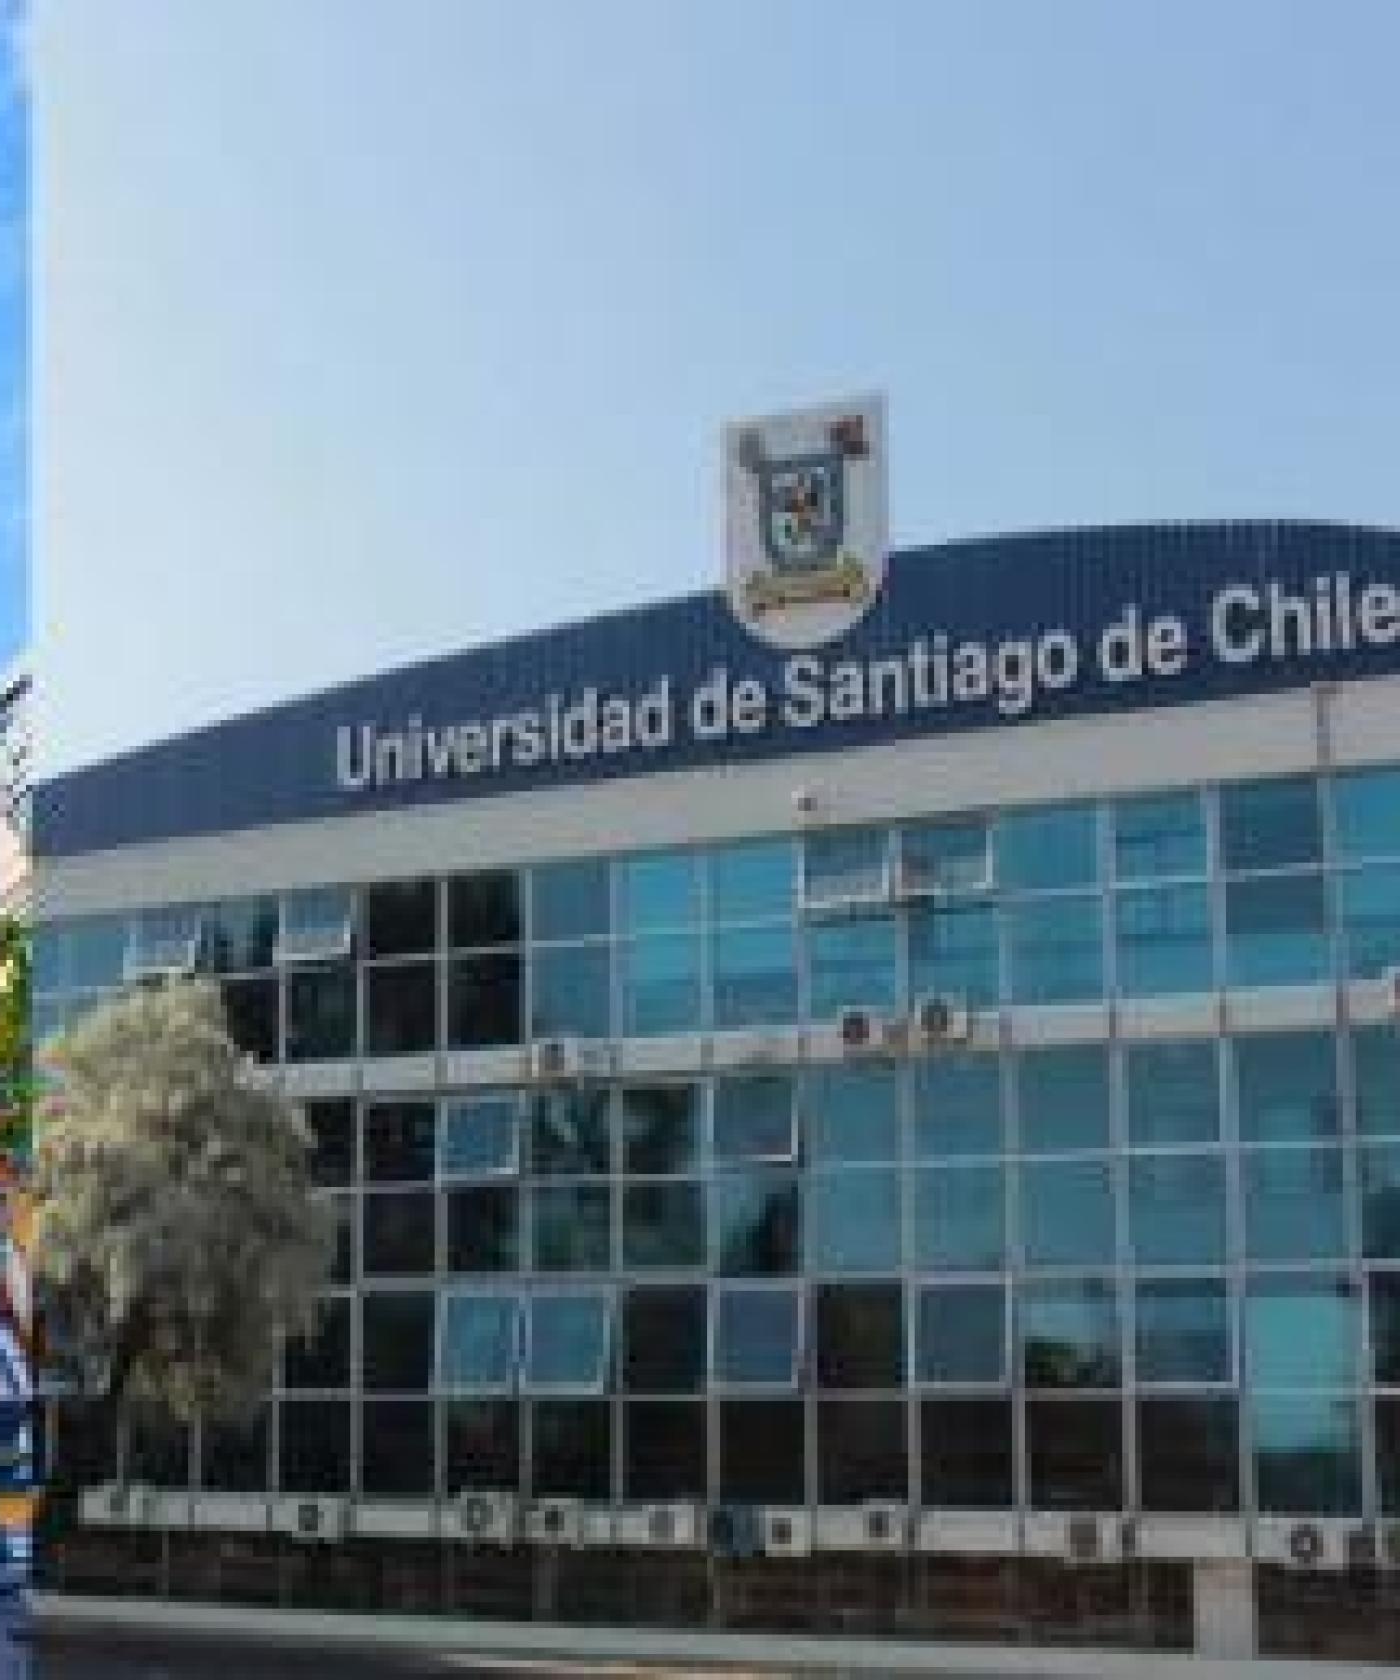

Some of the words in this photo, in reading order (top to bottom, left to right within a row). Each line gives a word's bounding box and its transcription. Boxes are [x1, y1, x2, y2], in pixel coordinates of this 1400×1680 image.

[336, 674, 670, 786] Universidad
[692, 668, 767, 734] de
[784, 628, 1078, 727] Santiago
[1097, 604, 1188, 681] de
[1211, 570, 1400, 663] Chile
